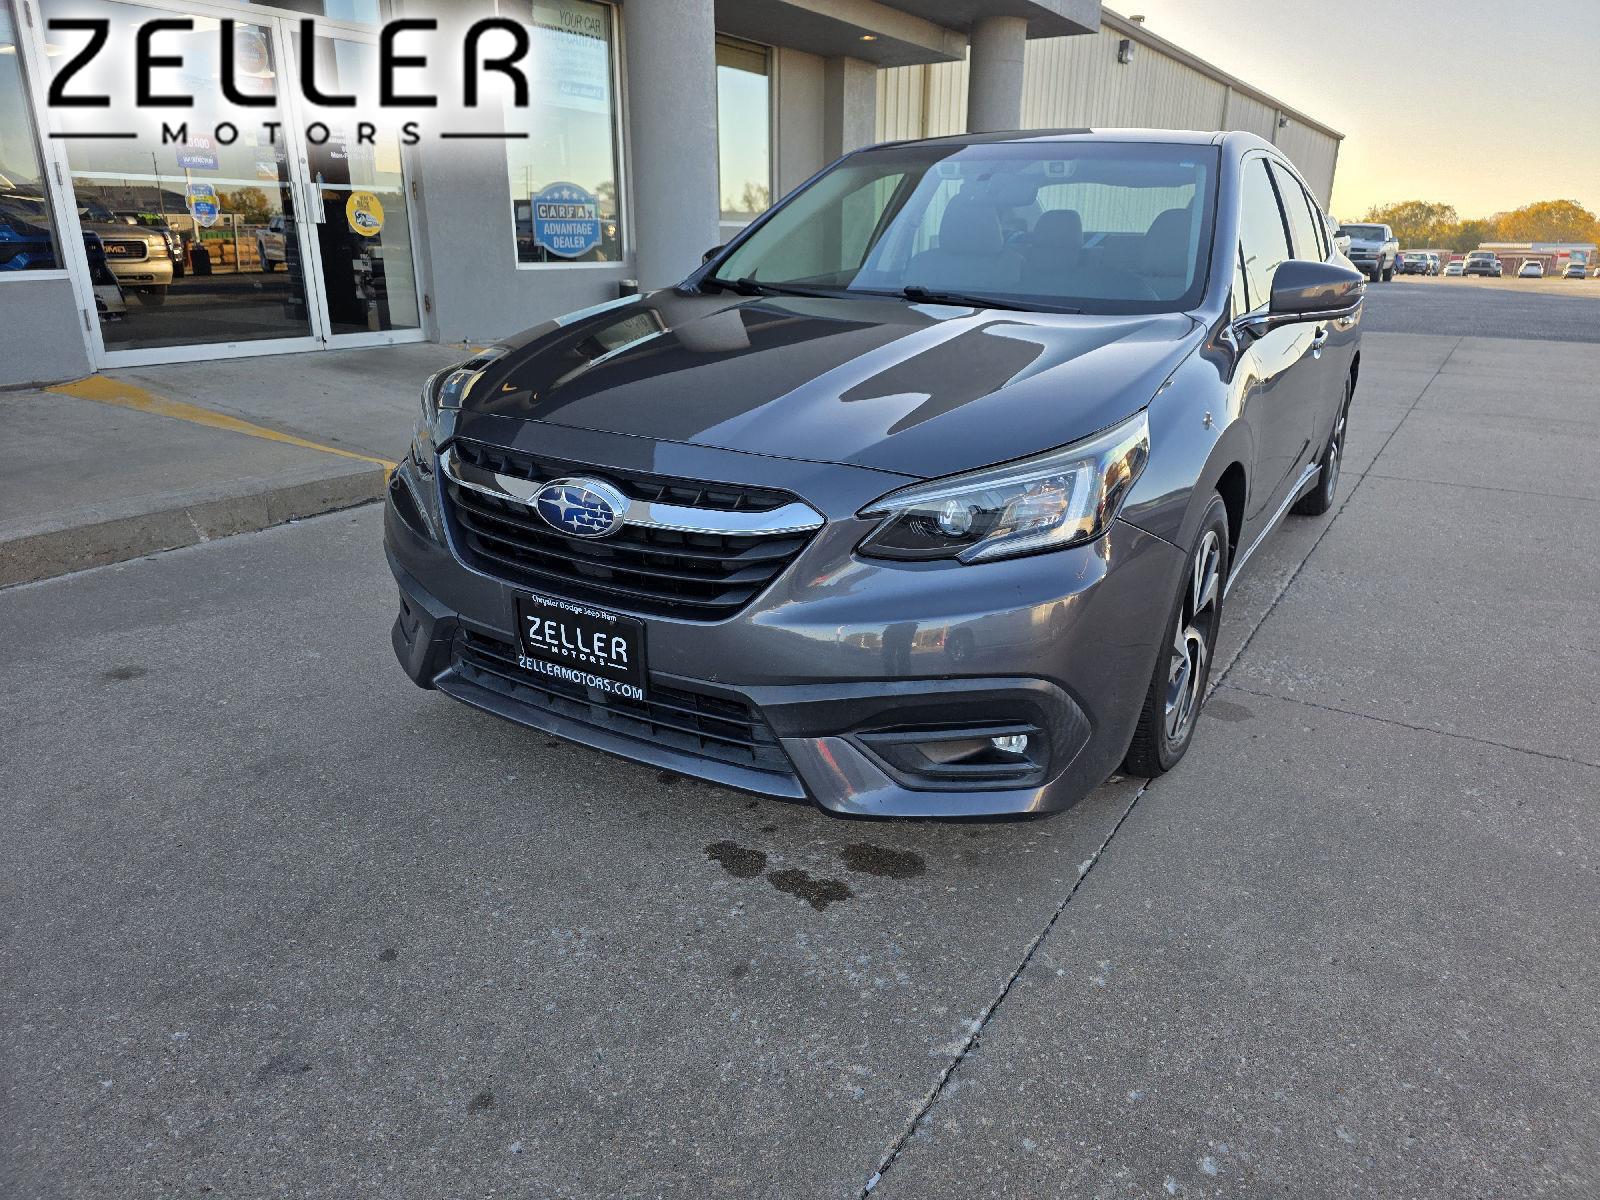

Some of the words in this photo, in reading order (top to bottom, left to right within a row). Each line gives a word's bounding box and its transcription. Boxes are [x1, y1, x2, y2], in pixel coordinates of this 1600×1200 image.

[560, 8, 582, 28] YOUR
[584, 16, 601, 32] CAR
[537, 204, 595, 219] CARFAX
[543, 222, 593, 235] ADVANTAGE
[553, 235, 586, 249] DEALER
[531, 594, 559, 608] Chrysler
[559, 601, 583, 615] Dodge
[583, 607, 601, 619] Jeep
[601, 611, 617, 622] Ram
[526, 615, 628, 663] ZELLER
[551, 645, 606, 666] MOTORS
[518, 655, 643, 701] ZELLERMOTORS.COM
